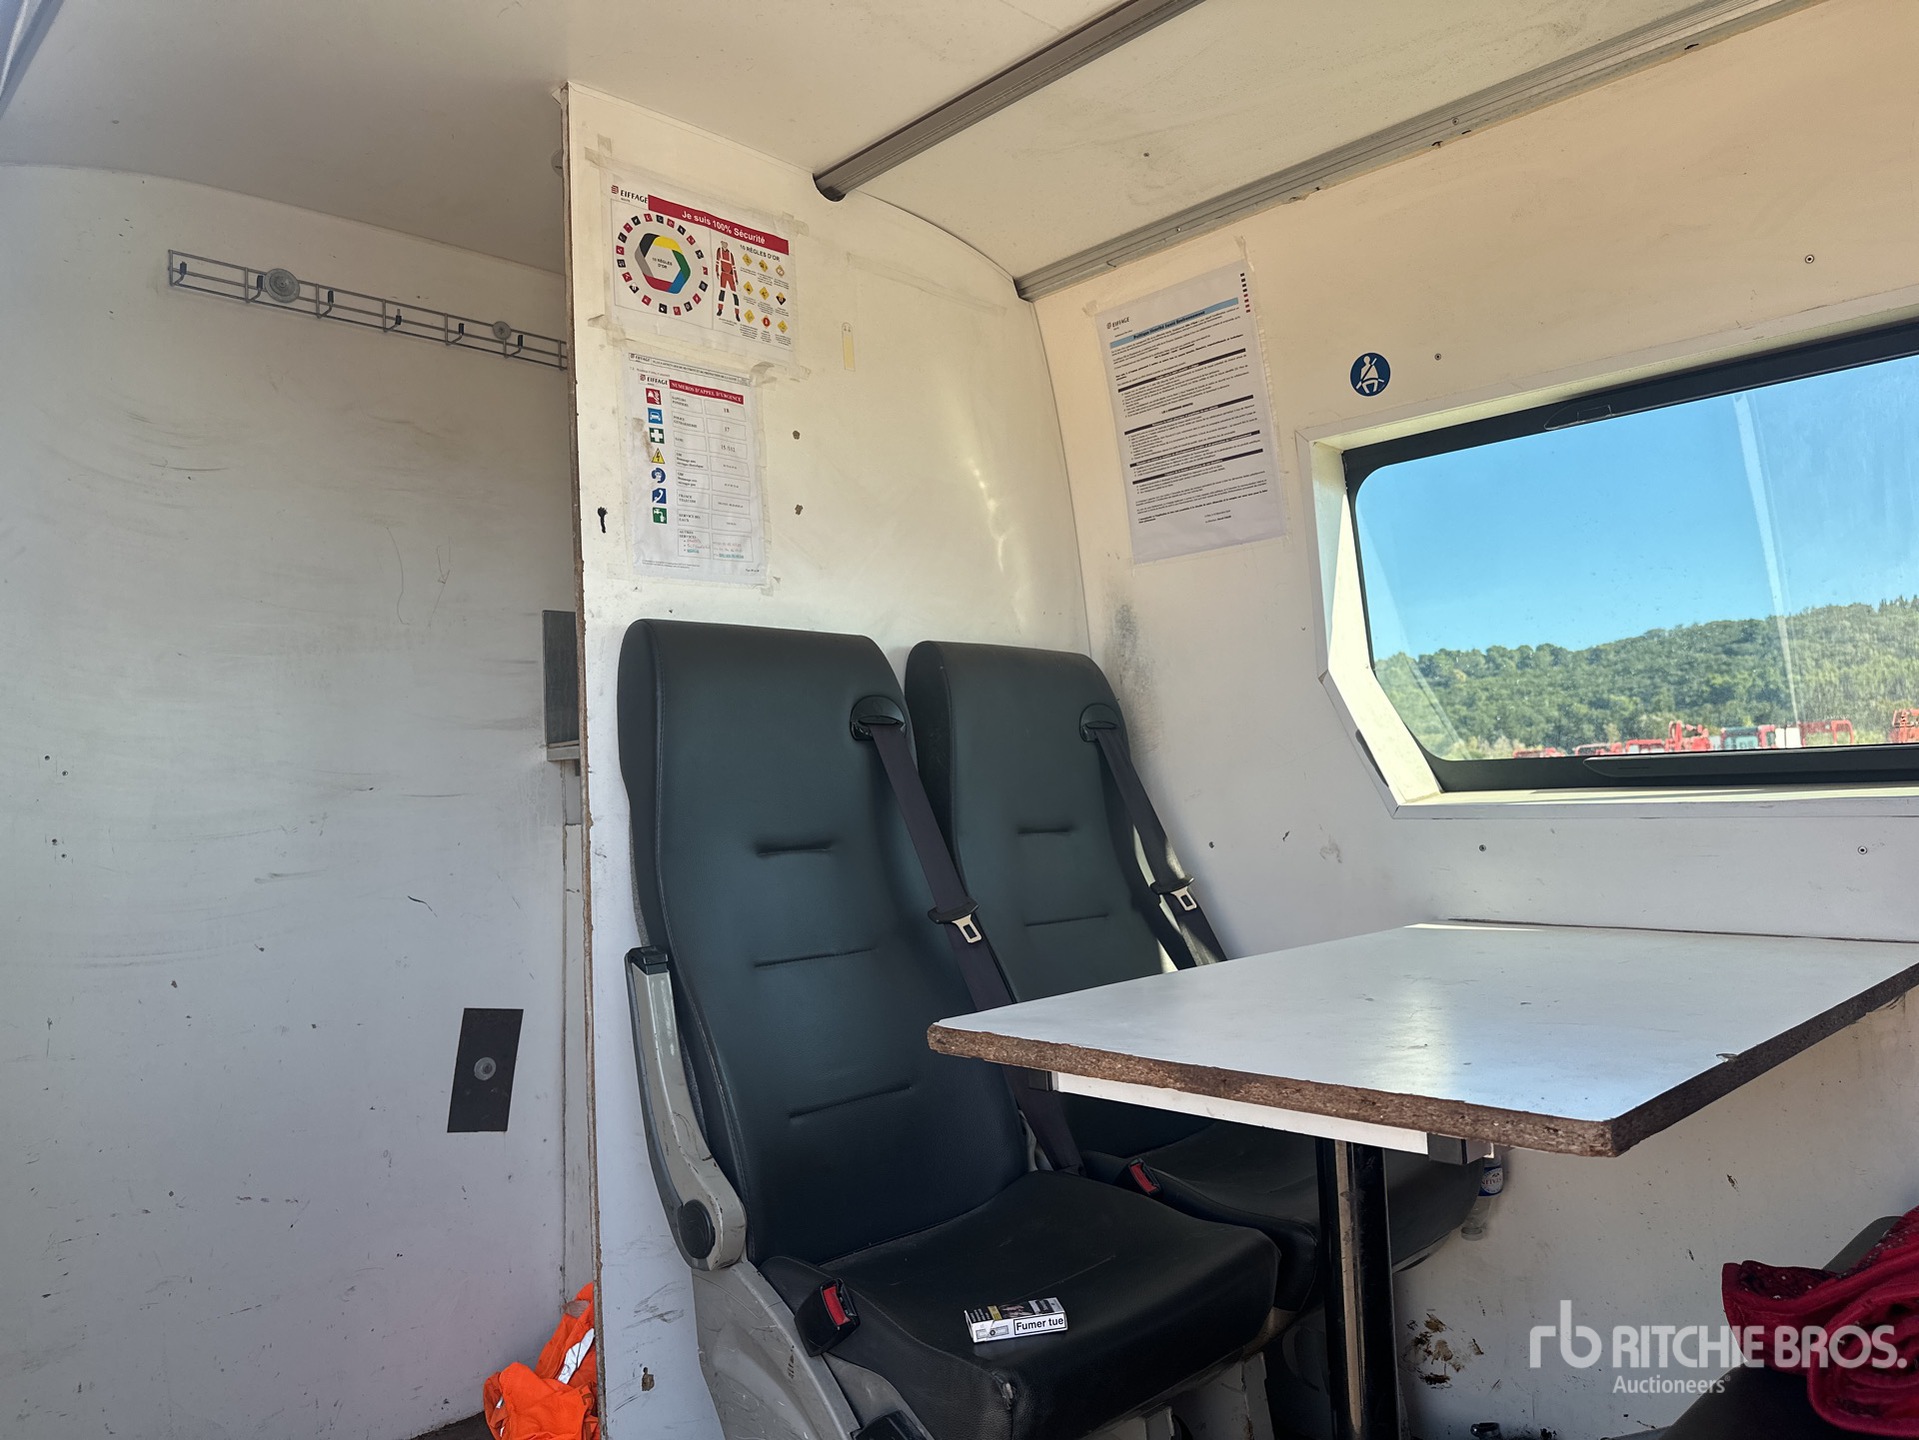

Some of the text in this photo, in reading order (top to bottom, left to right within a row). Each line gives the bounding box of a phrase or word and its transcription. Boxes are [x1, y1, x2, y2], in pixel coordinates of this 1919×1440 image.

[620, 190, 648, 204] EIFFAGE
[681, 211, 766, 244] Je suis 100% Sécurité
[1016, 1317, 1064, 1331] Fumer tue
